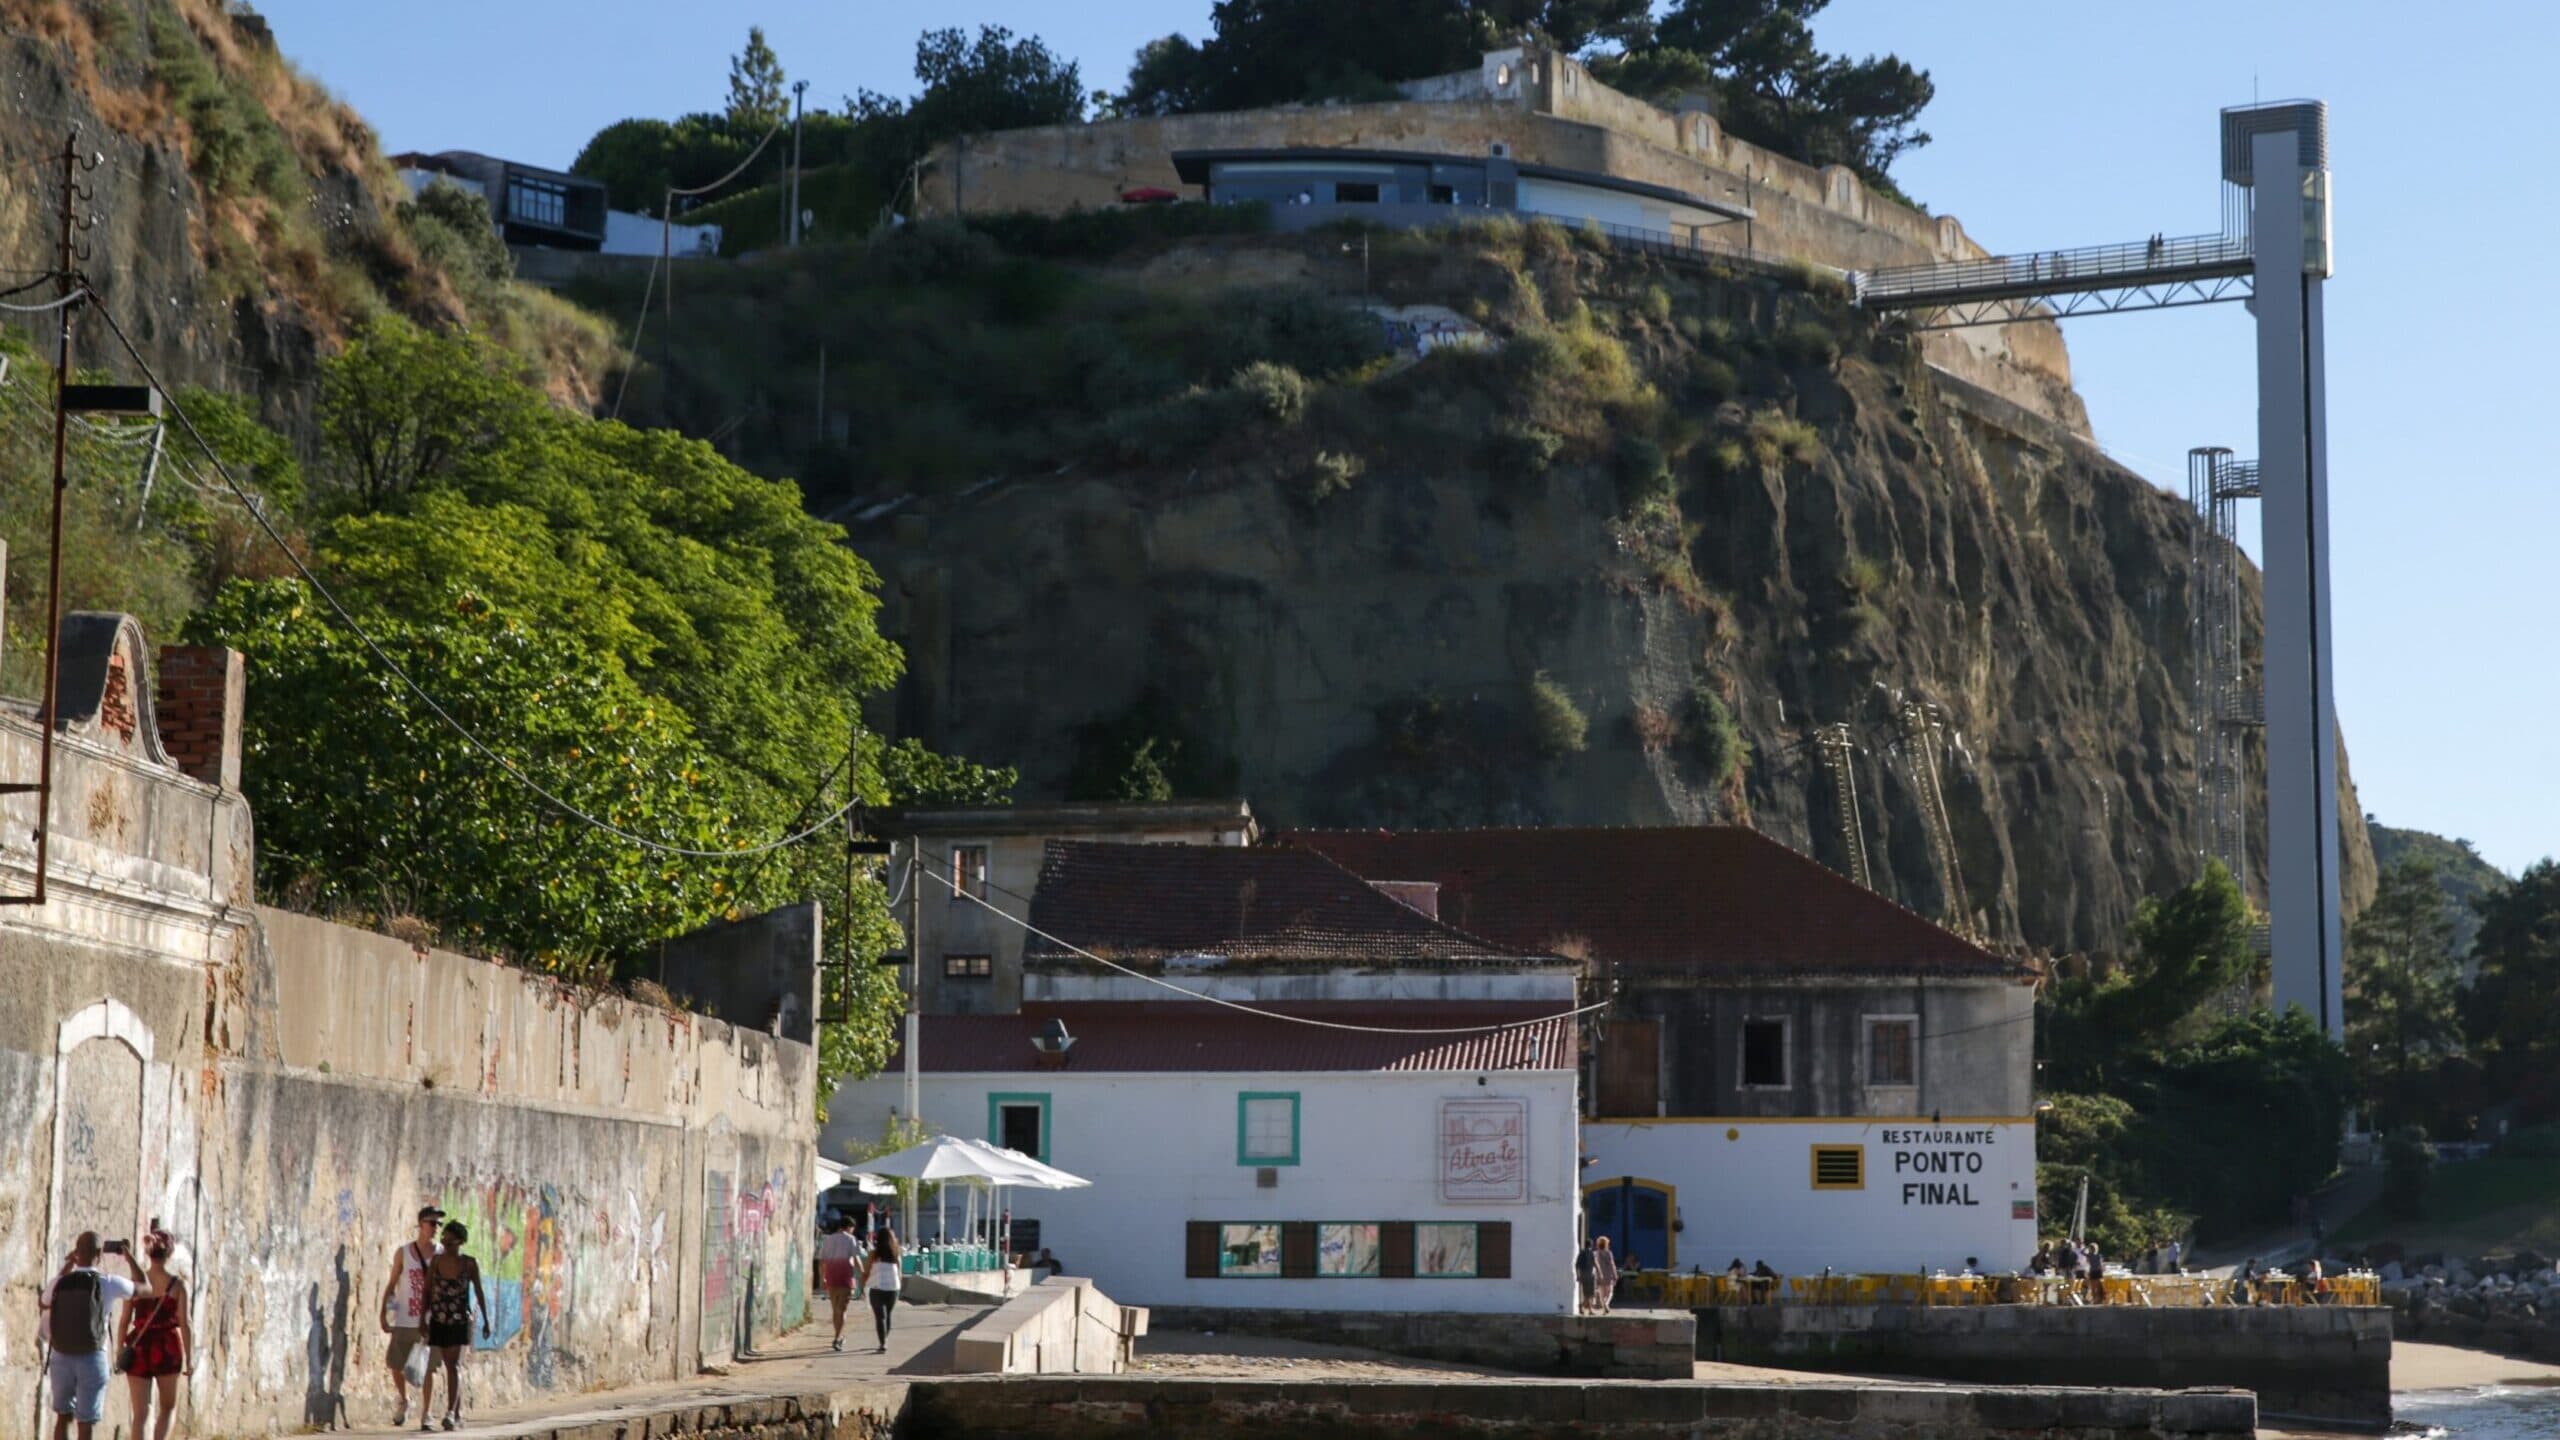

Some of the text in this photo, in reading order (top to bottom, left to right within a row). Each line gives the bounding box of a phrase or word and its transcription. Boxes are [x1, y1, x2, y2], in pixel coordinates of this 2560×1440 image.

[1882, 1130, 1995, 1144] RESTAURANTE
[1895, 1151, 1983, 1174] PONTO
[1902, 1183, 1980, 1206] FINAL
